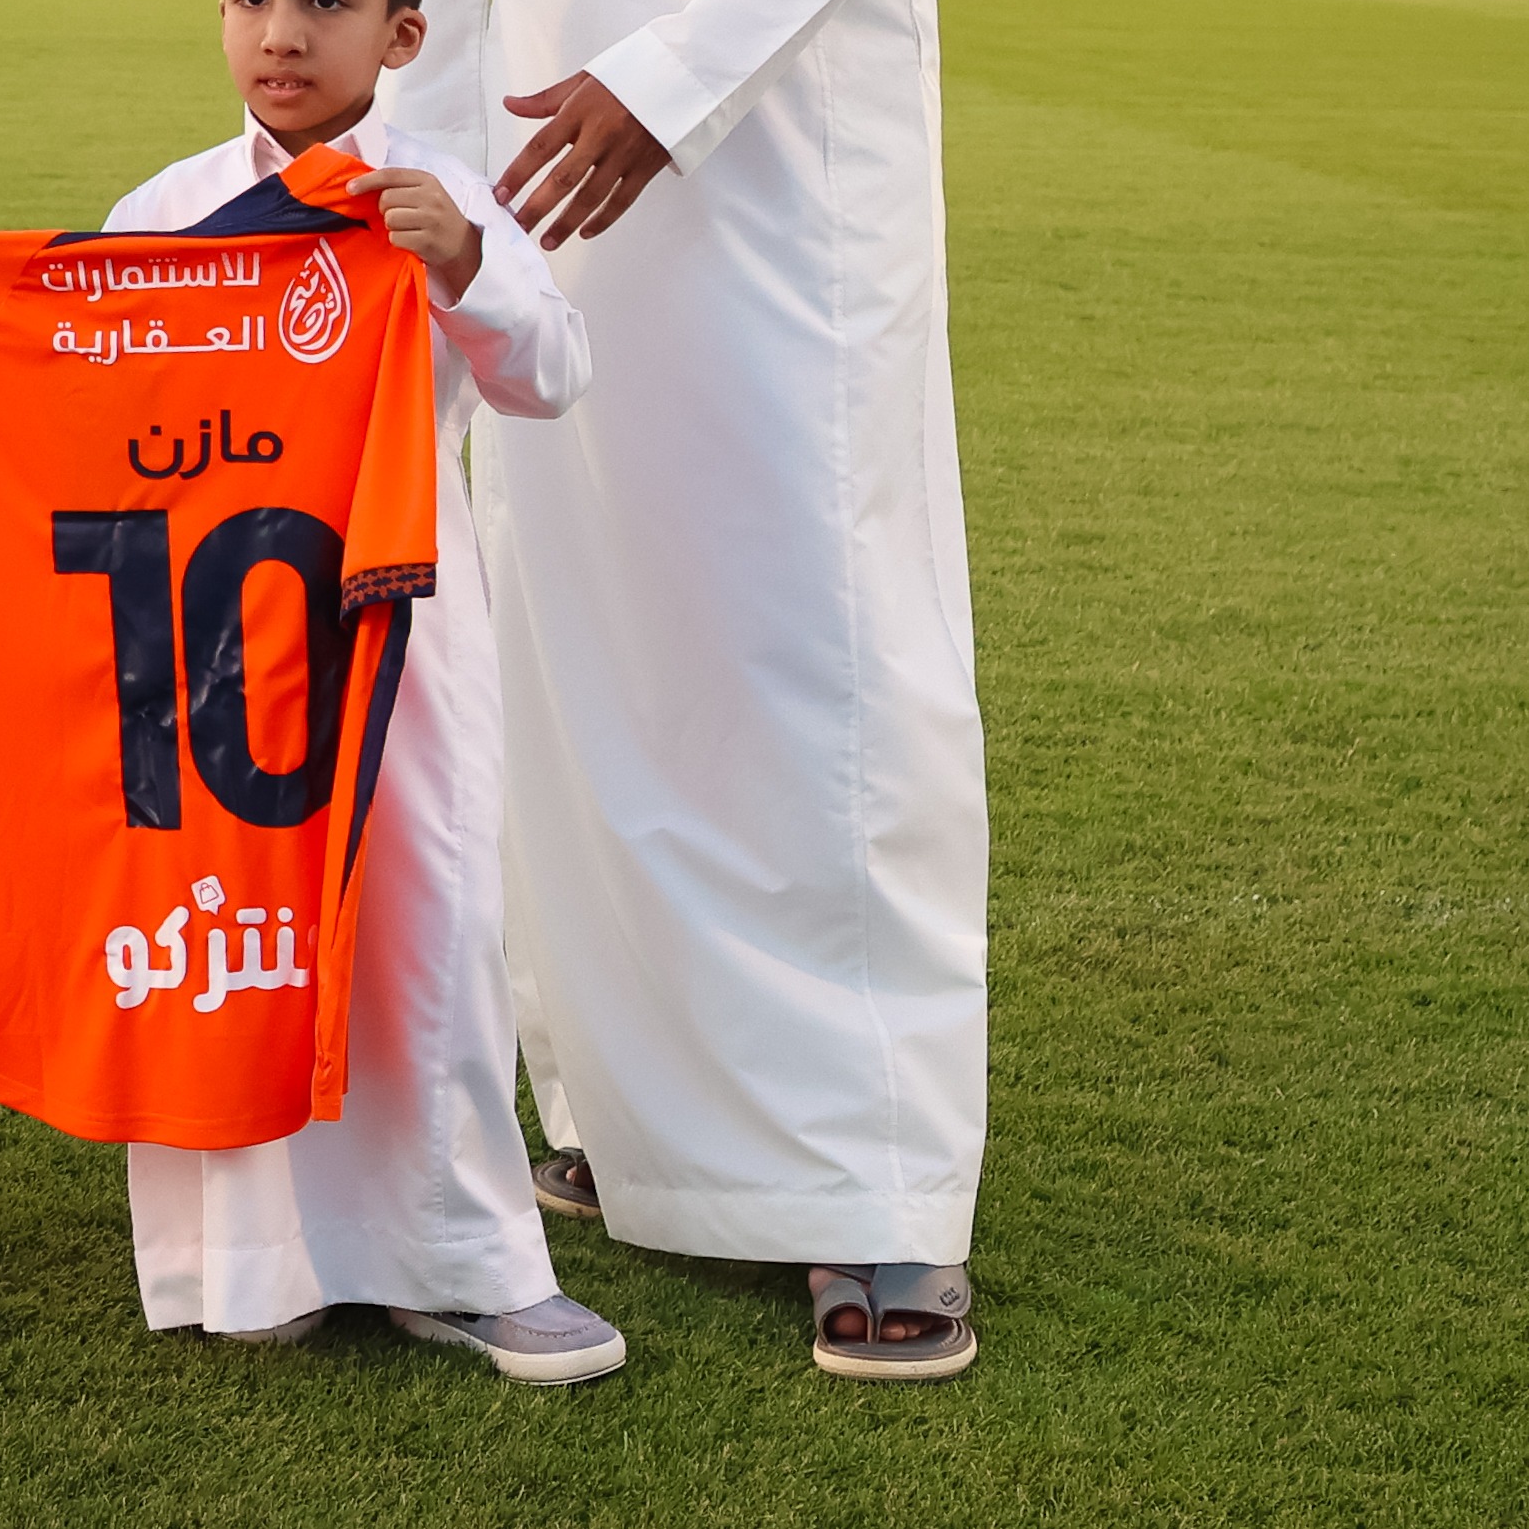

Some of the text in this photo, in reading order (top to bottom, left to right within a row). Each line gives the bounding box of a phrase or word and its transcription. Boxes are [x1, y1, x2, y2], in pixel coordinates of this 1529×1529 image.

[53, 315, 265, 365] العقارية
[128, 409, 283, 479] مازن
[52, 507, 345, 830] 10
[104, 905, 310, 1013] نتركو
